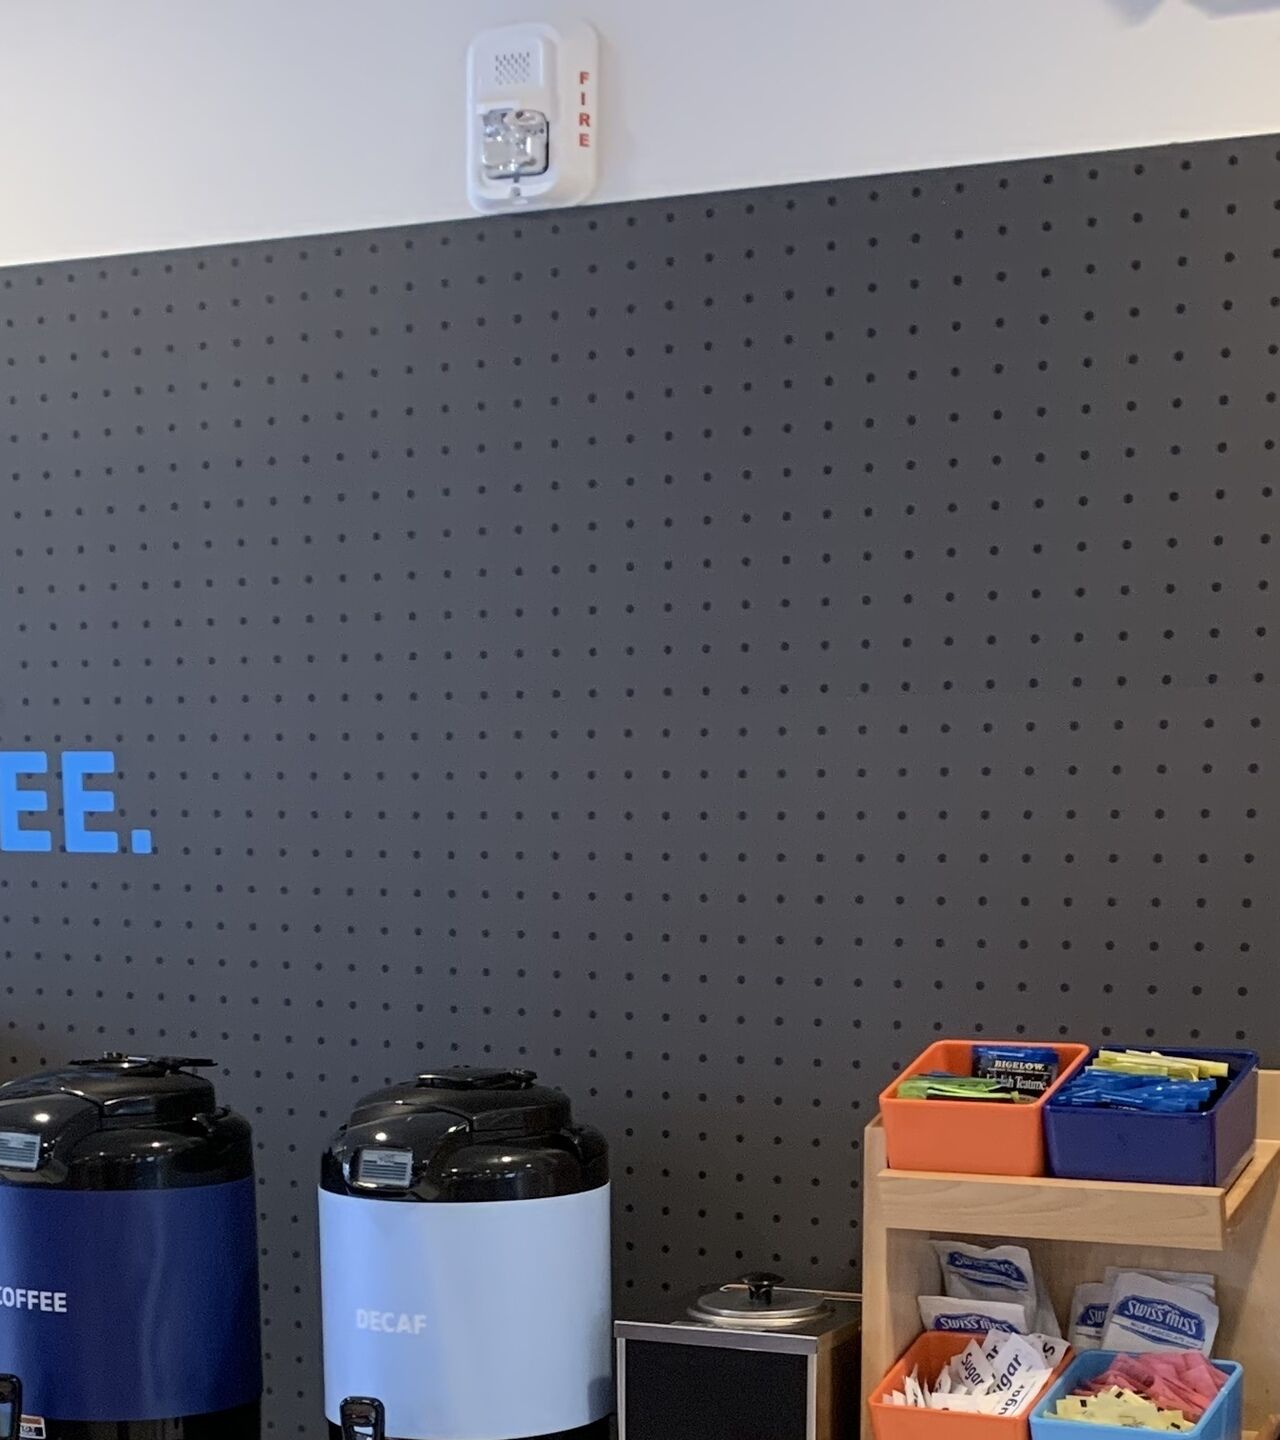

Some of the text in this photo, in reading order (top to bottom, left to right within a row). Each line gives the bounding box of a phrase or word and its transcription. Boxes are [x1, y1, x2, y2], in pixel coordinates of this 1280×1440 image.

[578, 71, 591, 148] FIRE
[355, 1309, 428, 1335] DECAF
[961, 1352, 985, 1387] Sugar
